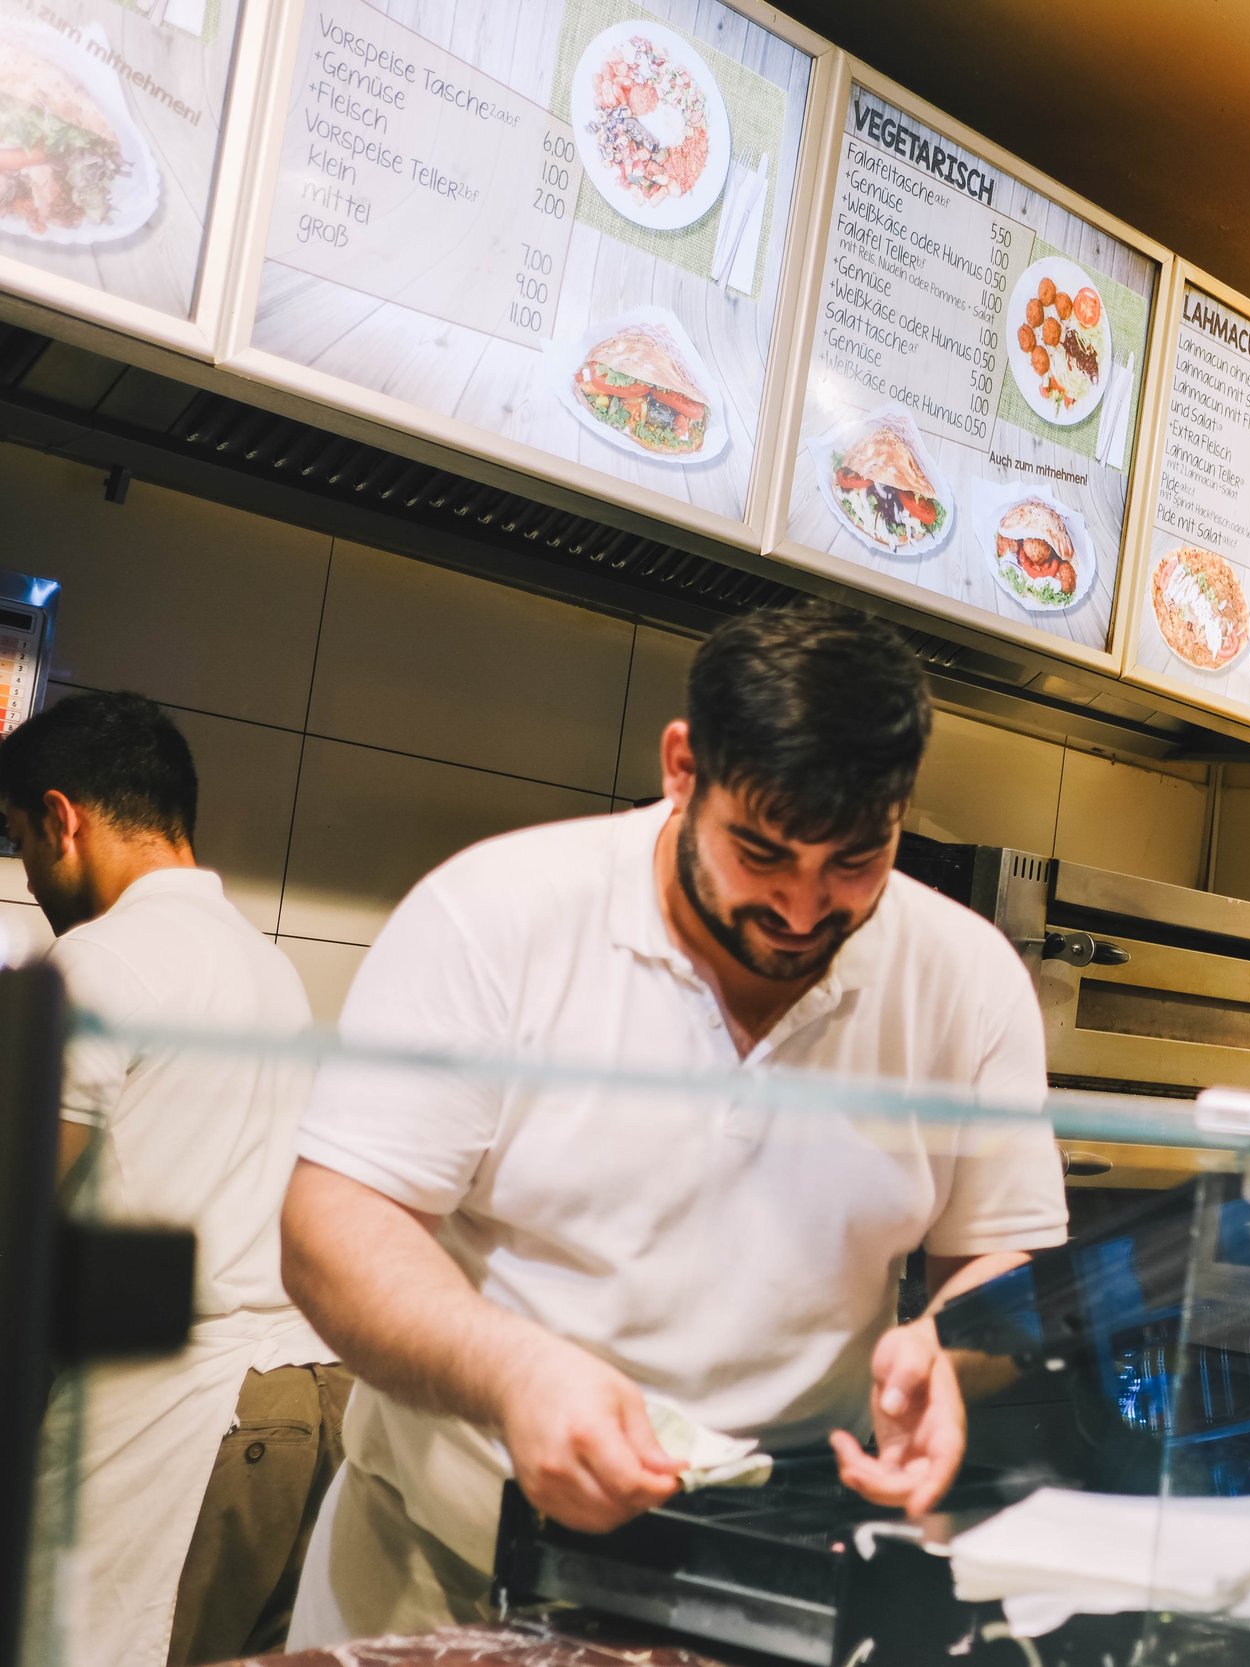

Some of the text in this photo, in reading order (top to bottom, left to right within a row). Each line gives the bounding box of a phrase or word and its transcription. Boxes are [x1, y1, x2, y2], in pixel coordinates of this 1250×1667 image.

[38, 5, 201, 127] zum mitnehmen!
[543, 130, 575, 163] 6,00
[854, 100, 995, 206] VEGETARISCH
[542, 160, 569, 190] 1,00
[307, 144, 552, 275] klein 7,00
[533, 188, 565, 220] 2,00
[303, 182, 548, 304] mittel 9,00
[990, 222, 1012, 248] 5,50
[836, 213, 882, 251] Falafel
[981, 289, 1002, 314] 11,00
[942, 244, 983, 281] Humus
[984, 267, 1007, 293] 0,50
[990, 247, 1010, 271] 1,00
[840, 239, 857, 253] mit
[878, 256, 908, 281] Nudeln
[930, 283, 966, 311] Pommes
[972, 306, 995, 325] Salat
[509, 301, 542, 332] 11,00
[931, 326, 971, 361] Humus
[973, 347, 996, 372] 0,50
[979, 327, 998, 350] 1,00
[1178, 333, 1229, 374] Lahmacun
[970, 370, 993, 394] 5,00
[1176, 354, 1226, 394] Lahmacun
[1227, 384, 1244, 404] mit
[922, 394, 963, 429] Humus
[964, 415, 987, 439] 0,50
[971, 393, 989, 416] 1,00
[1170, 400, 1190, 418] und
[1173, 375, 1223, 415] Lahmacun
[1224, 405, 1241, 425] mit
[1165, 440, 1216, 477] Lahmacun
[1201, 434, 1232, 463] Fleisch
[989, 451, 1088, 486] Auch zum mitnehmen!
[1161, 472, 1179, 493] Pide
[1157, 503, 1175, 526] Pide
[1177, 515, 1195, 533] mit
